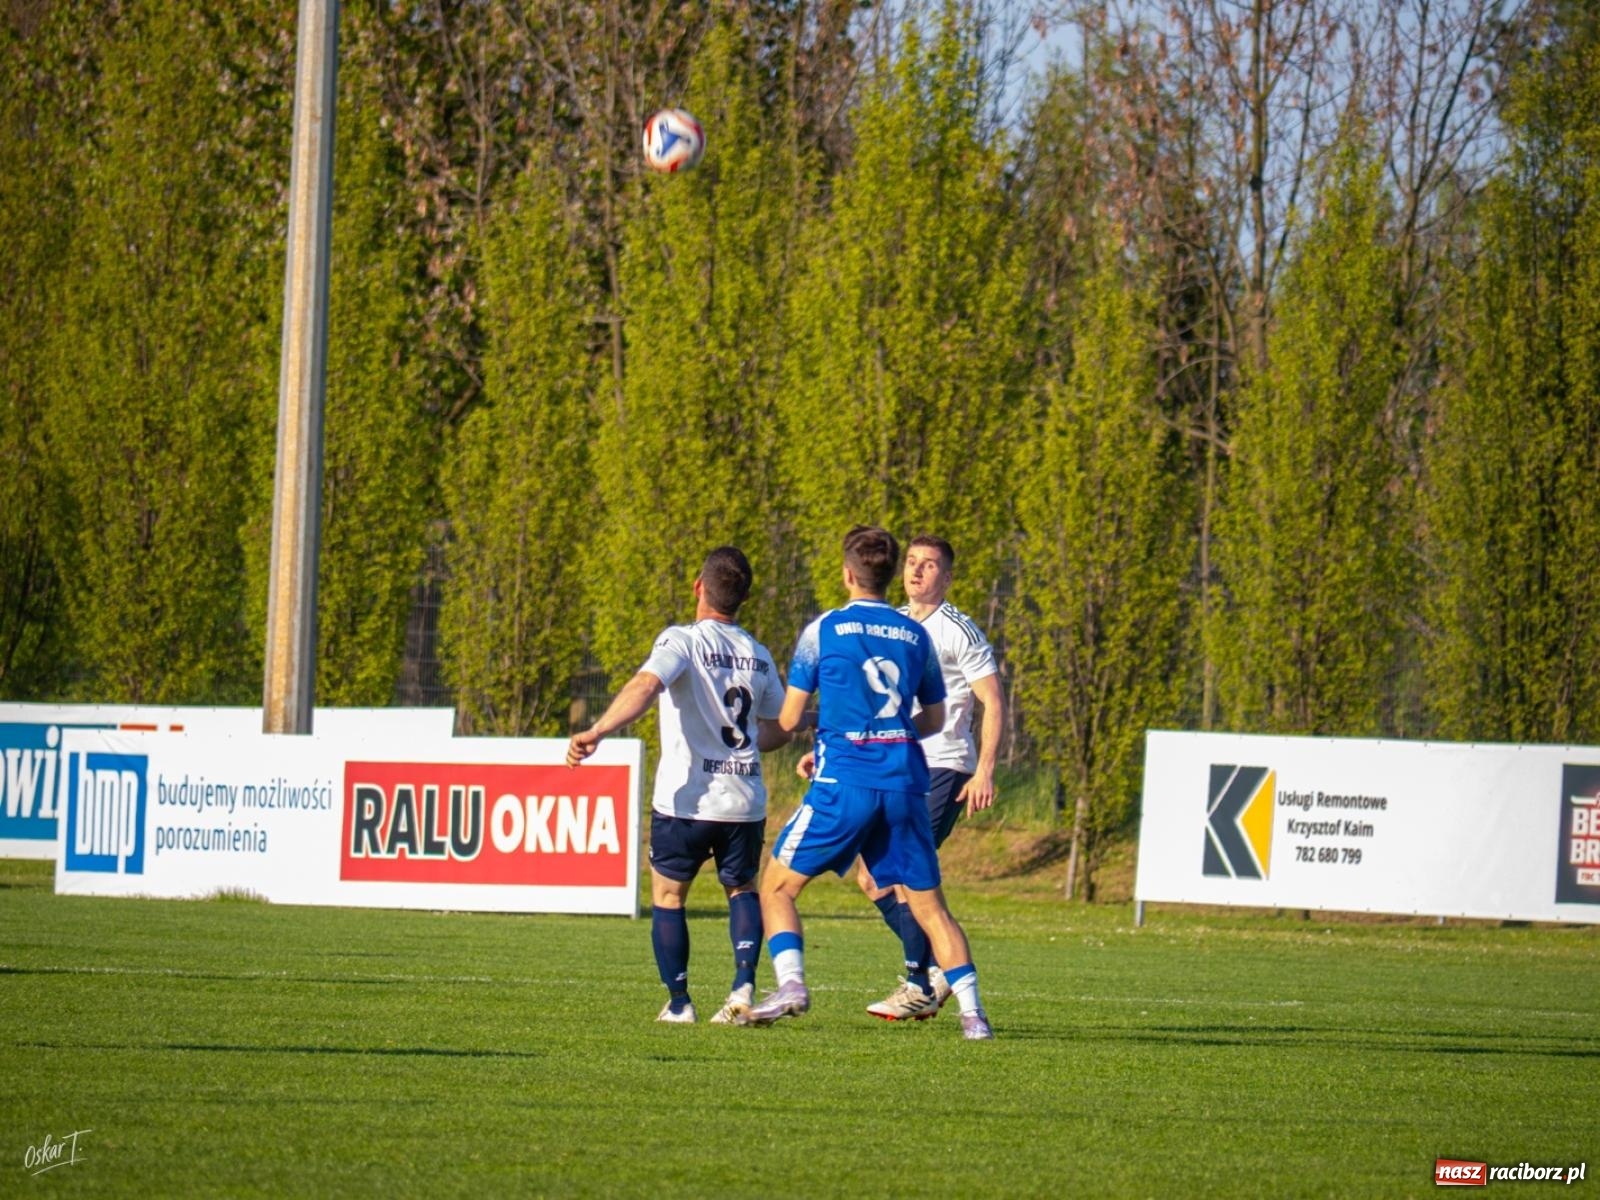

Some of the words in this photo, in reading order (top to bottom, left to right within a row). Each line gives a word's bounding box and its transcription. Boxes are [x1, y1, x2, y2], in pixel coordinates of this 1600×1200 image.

[862, 656, 902, 719] 9
[721, 685, 752, 750] 3
[75, 752, 139, 873] bmp
[158, 774, 238, 814] budujemy
[242, 777, 332, 810] możliwości
[1278, 791, 1314, 811] Usługi
[1317, 792, 1388, 810] Remontowe
[155, 822, 267, 855] porozumienia
[350, 783, 485, 862] RALU
[490, 794, 620, 854] OKNA
[1287, 818, 1342, 839] Krzysztof
[1344, 819, 1374, 837] Kaim
[1295, 846, 1315, 862] 782
[1318, 847, 1338, 863] 680
[1341, 848, 1363, 864] 799
